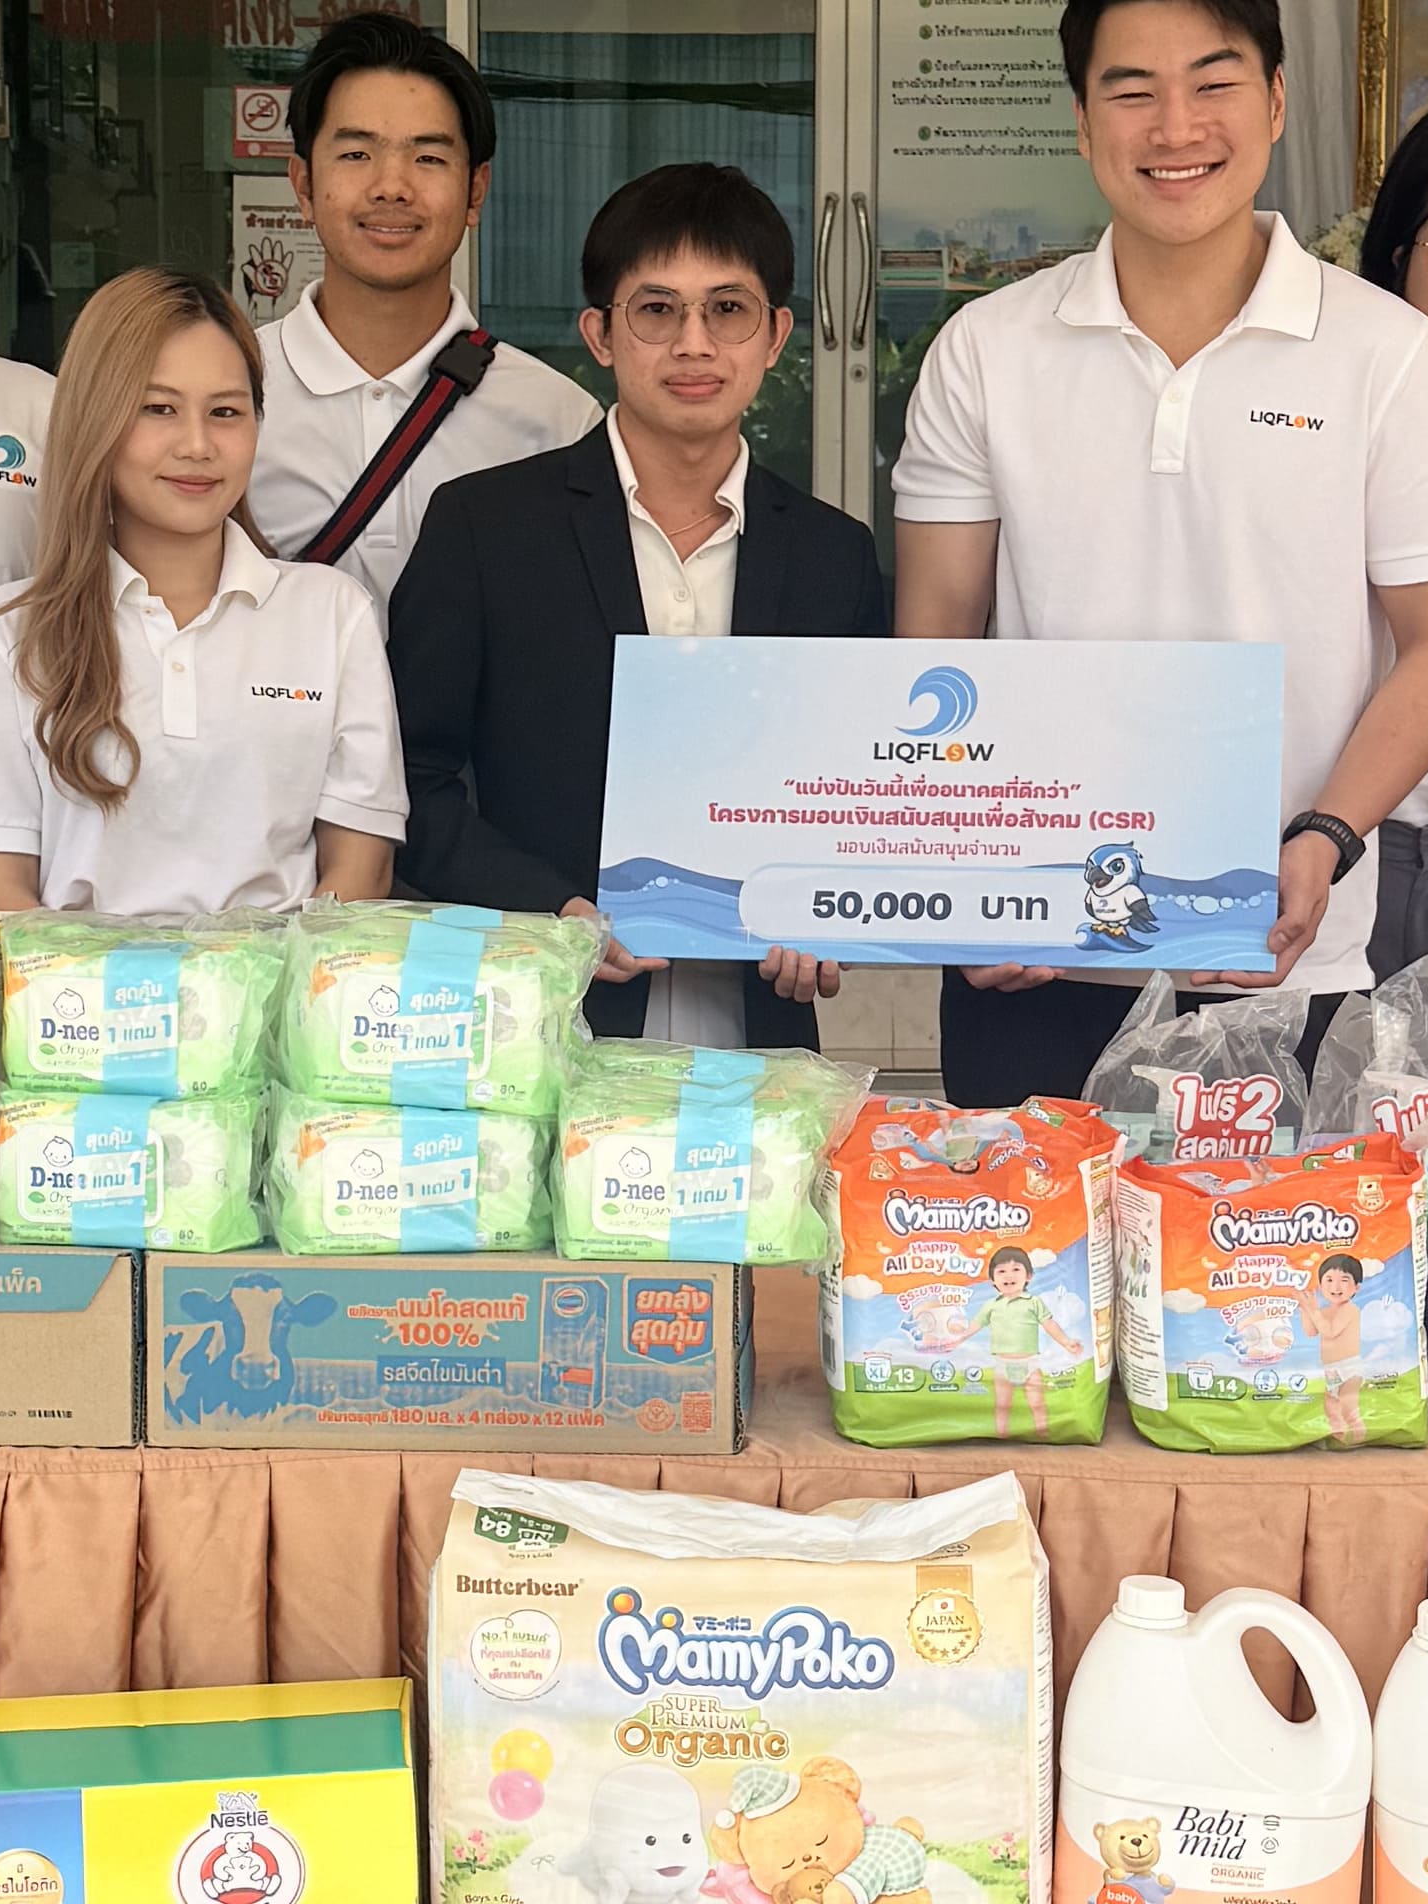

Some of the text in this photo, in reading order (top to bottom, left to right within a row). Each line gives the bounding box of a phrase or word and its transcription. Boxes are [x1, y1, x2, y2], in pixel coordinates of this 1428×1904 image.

[1250, 409, 1324, 432] LIQFLOW
[252, 686, 323, 702] LIQFLOW
[873, 742, 994, 764] LIQFLOW
[709, 801, 1155, 834] โครงการมอบเงินสนับสนุนเพื่อสังคม (CSR)
[836, 837, 1021, 860] มอบเงินสนับสนุนจำนวน
[811, 890, 1049, 924] 50,000 บาท
[115, 981, 164, 1004] สุดคุ้ม
[41, 1018, 100, 1042] D-nee
[337, 1179, 399, 1202] D-nee
[604, 1177, 666, 1201] D-nee
[885, 1190, 1031, 1237] MamyPoko
[1211, 1201, 1359, 1252] MamyPoko
[912, 1241, 957, 1258] Happy
[886, 1255, 982, 1276] All Day Dry
[1212, 1270, 1310, 1290] All Day Dry
[397, 1290, 527, 1320] นมโคสดแท้
[635, 1283, 711, 1314] ยกลัง
[398, 1322, 483, 1347] 100%
[384, 1359, 502, 1385] รสจืดไขมันต่ำ
[456, 1574, 579, 1597] Butterbear
[926, 1615, 965, 1627] JAPAN
[600, 1587, 894, 1701] MamyPoko
[665, 1696, 722, 1715] SUPER
[649, 1711, 748, 1731] PREMIUM
[617, 1719, 790, 1767] Organic
[1173, 1805, 1246, 1838] Babi
[1211, 1866, 1266, 1882] ORGANIC
[1106, 1888, 1138, 1904] baby
